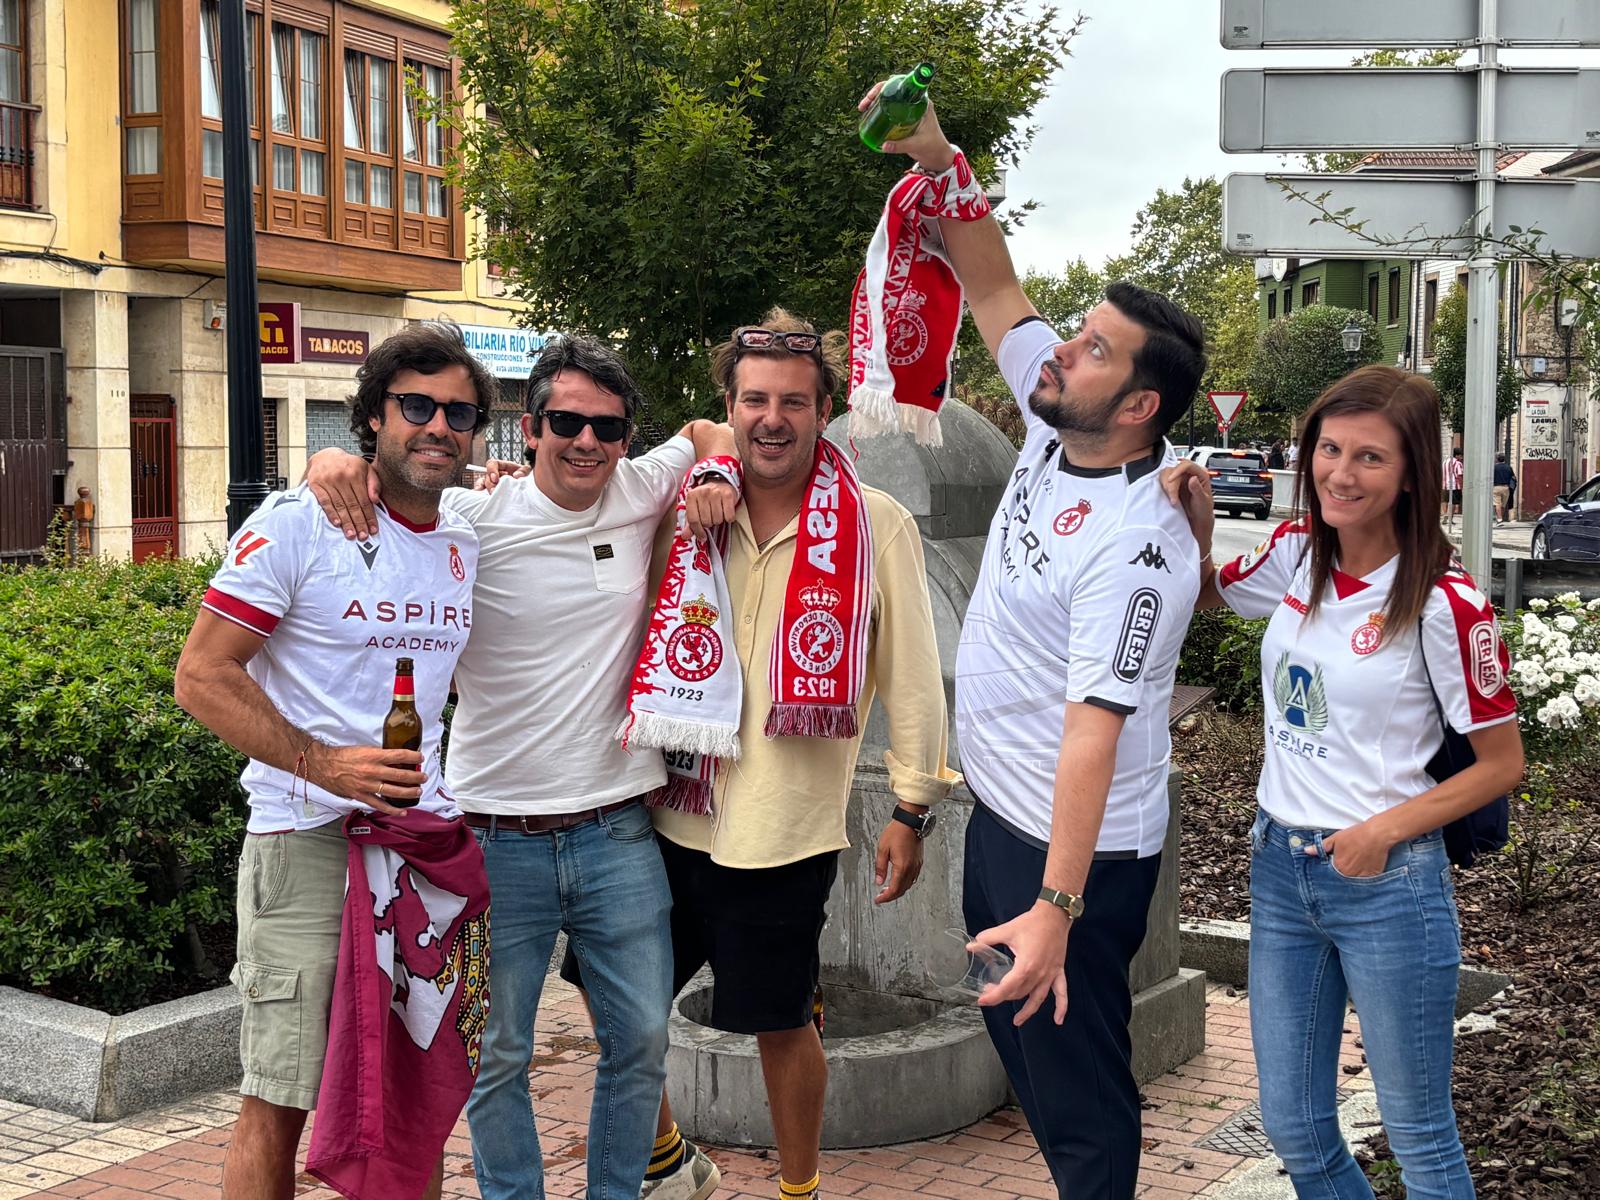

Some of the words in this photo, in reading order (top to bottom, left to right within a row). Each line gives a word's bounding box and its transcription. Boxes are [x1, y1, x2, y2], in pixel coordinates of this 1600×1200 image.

[260, 346, 289, 354] BACOS
[308, 337, 364, 355] TABACOS
[465, 331, 507, 351] BILIARIA
[365, 636, 459, 652] ACADEMY
[667, 626, 693, 656] CULTURAL
[700, 627, 721, 664] DEPORTIVA
[668, 659, 716, 680] LEONESA
[670, 686, 704, 701] 1923
[666, 749, 695, 771] 923
